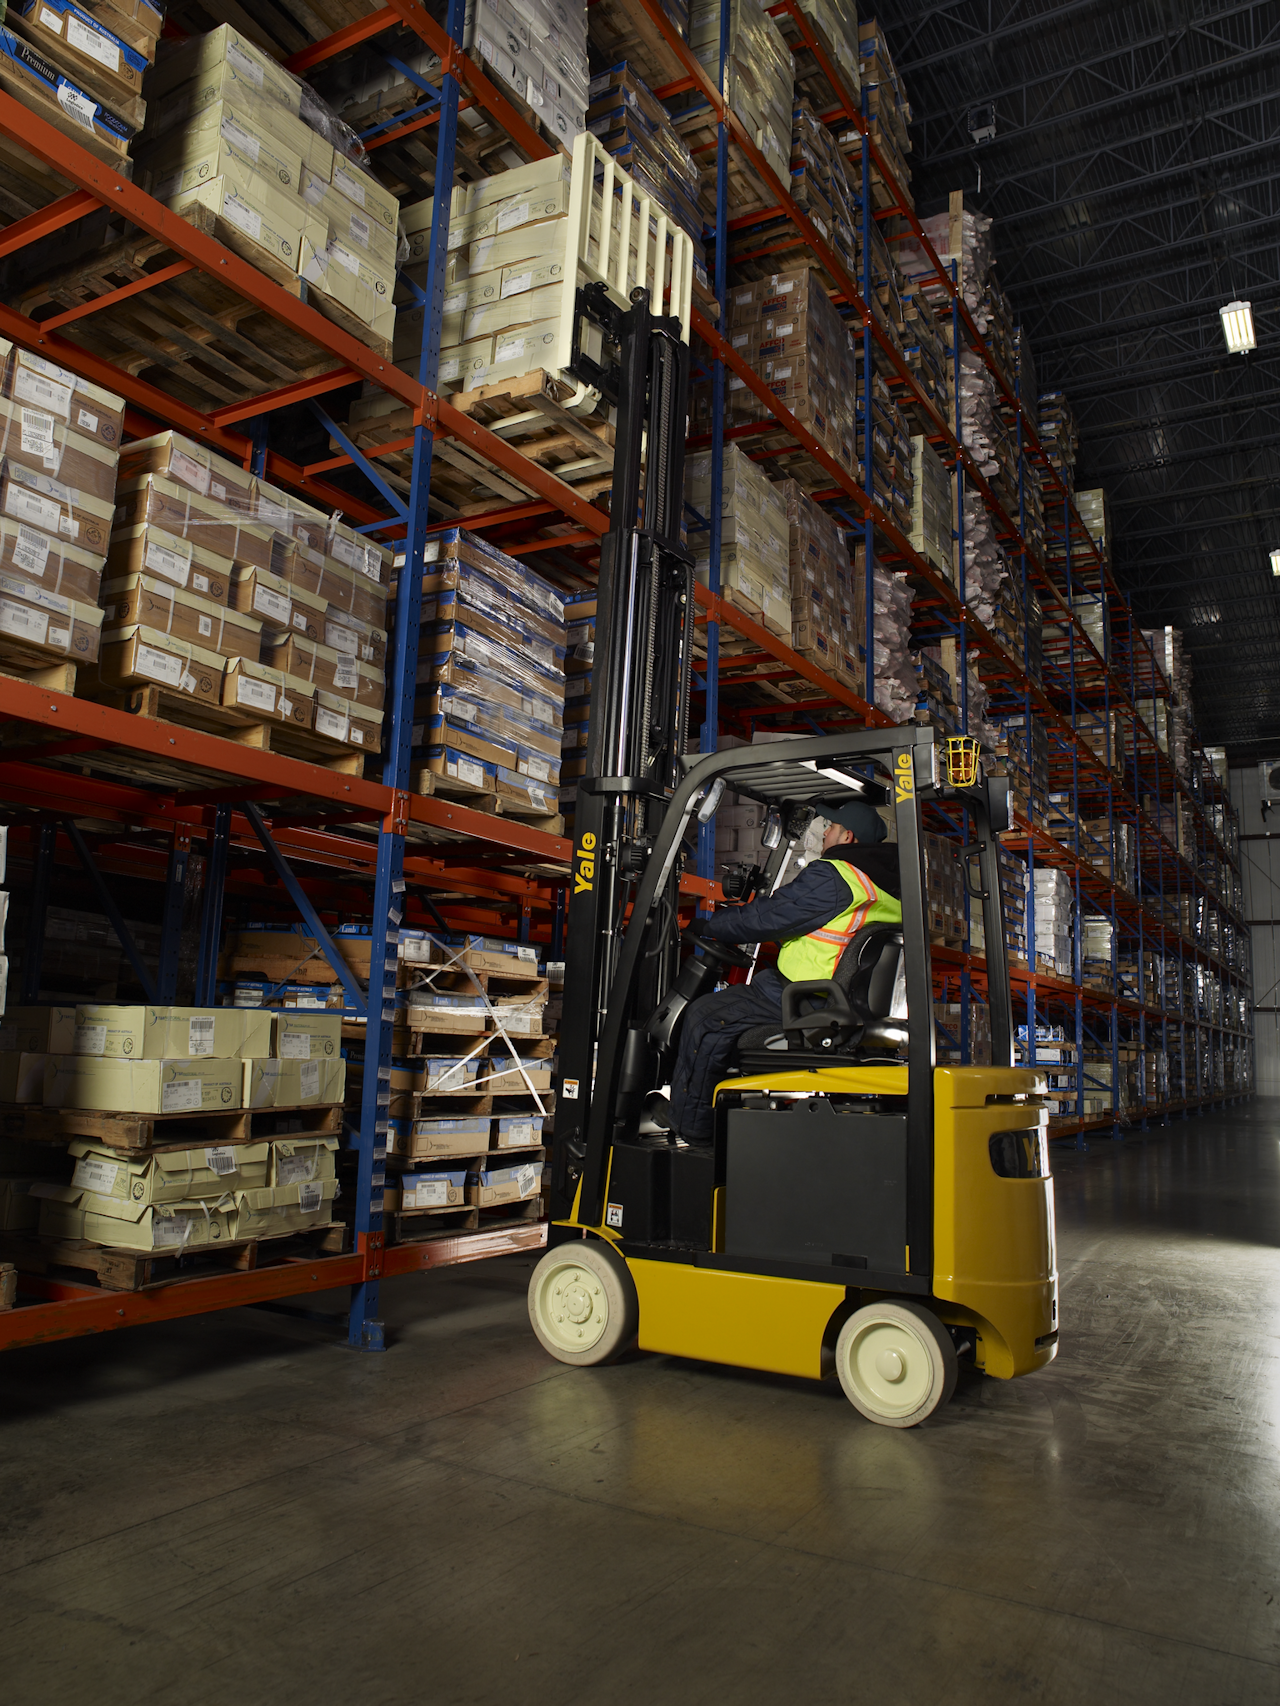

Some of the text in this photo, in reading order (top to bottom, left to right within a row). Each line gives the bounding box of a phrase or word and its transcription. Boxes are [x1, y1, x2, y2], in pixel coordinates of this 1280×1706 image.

[74, 8, 93, 26] PRODUCT
[98, 25, 120, 45] AUSTRALIA
[21, 47, 55, 80] Premium
[762, 295, 787, 306] AFFCO
[759, 338, 785, 349] AFFCO
[766, 380, 786, 389] FFCO
[468, 722, 483, 733] Lamb
[894, 752, 913, 804] Yale
[574, 831, 597, 895] Yale
[485, 941, 502, 950] Premium
